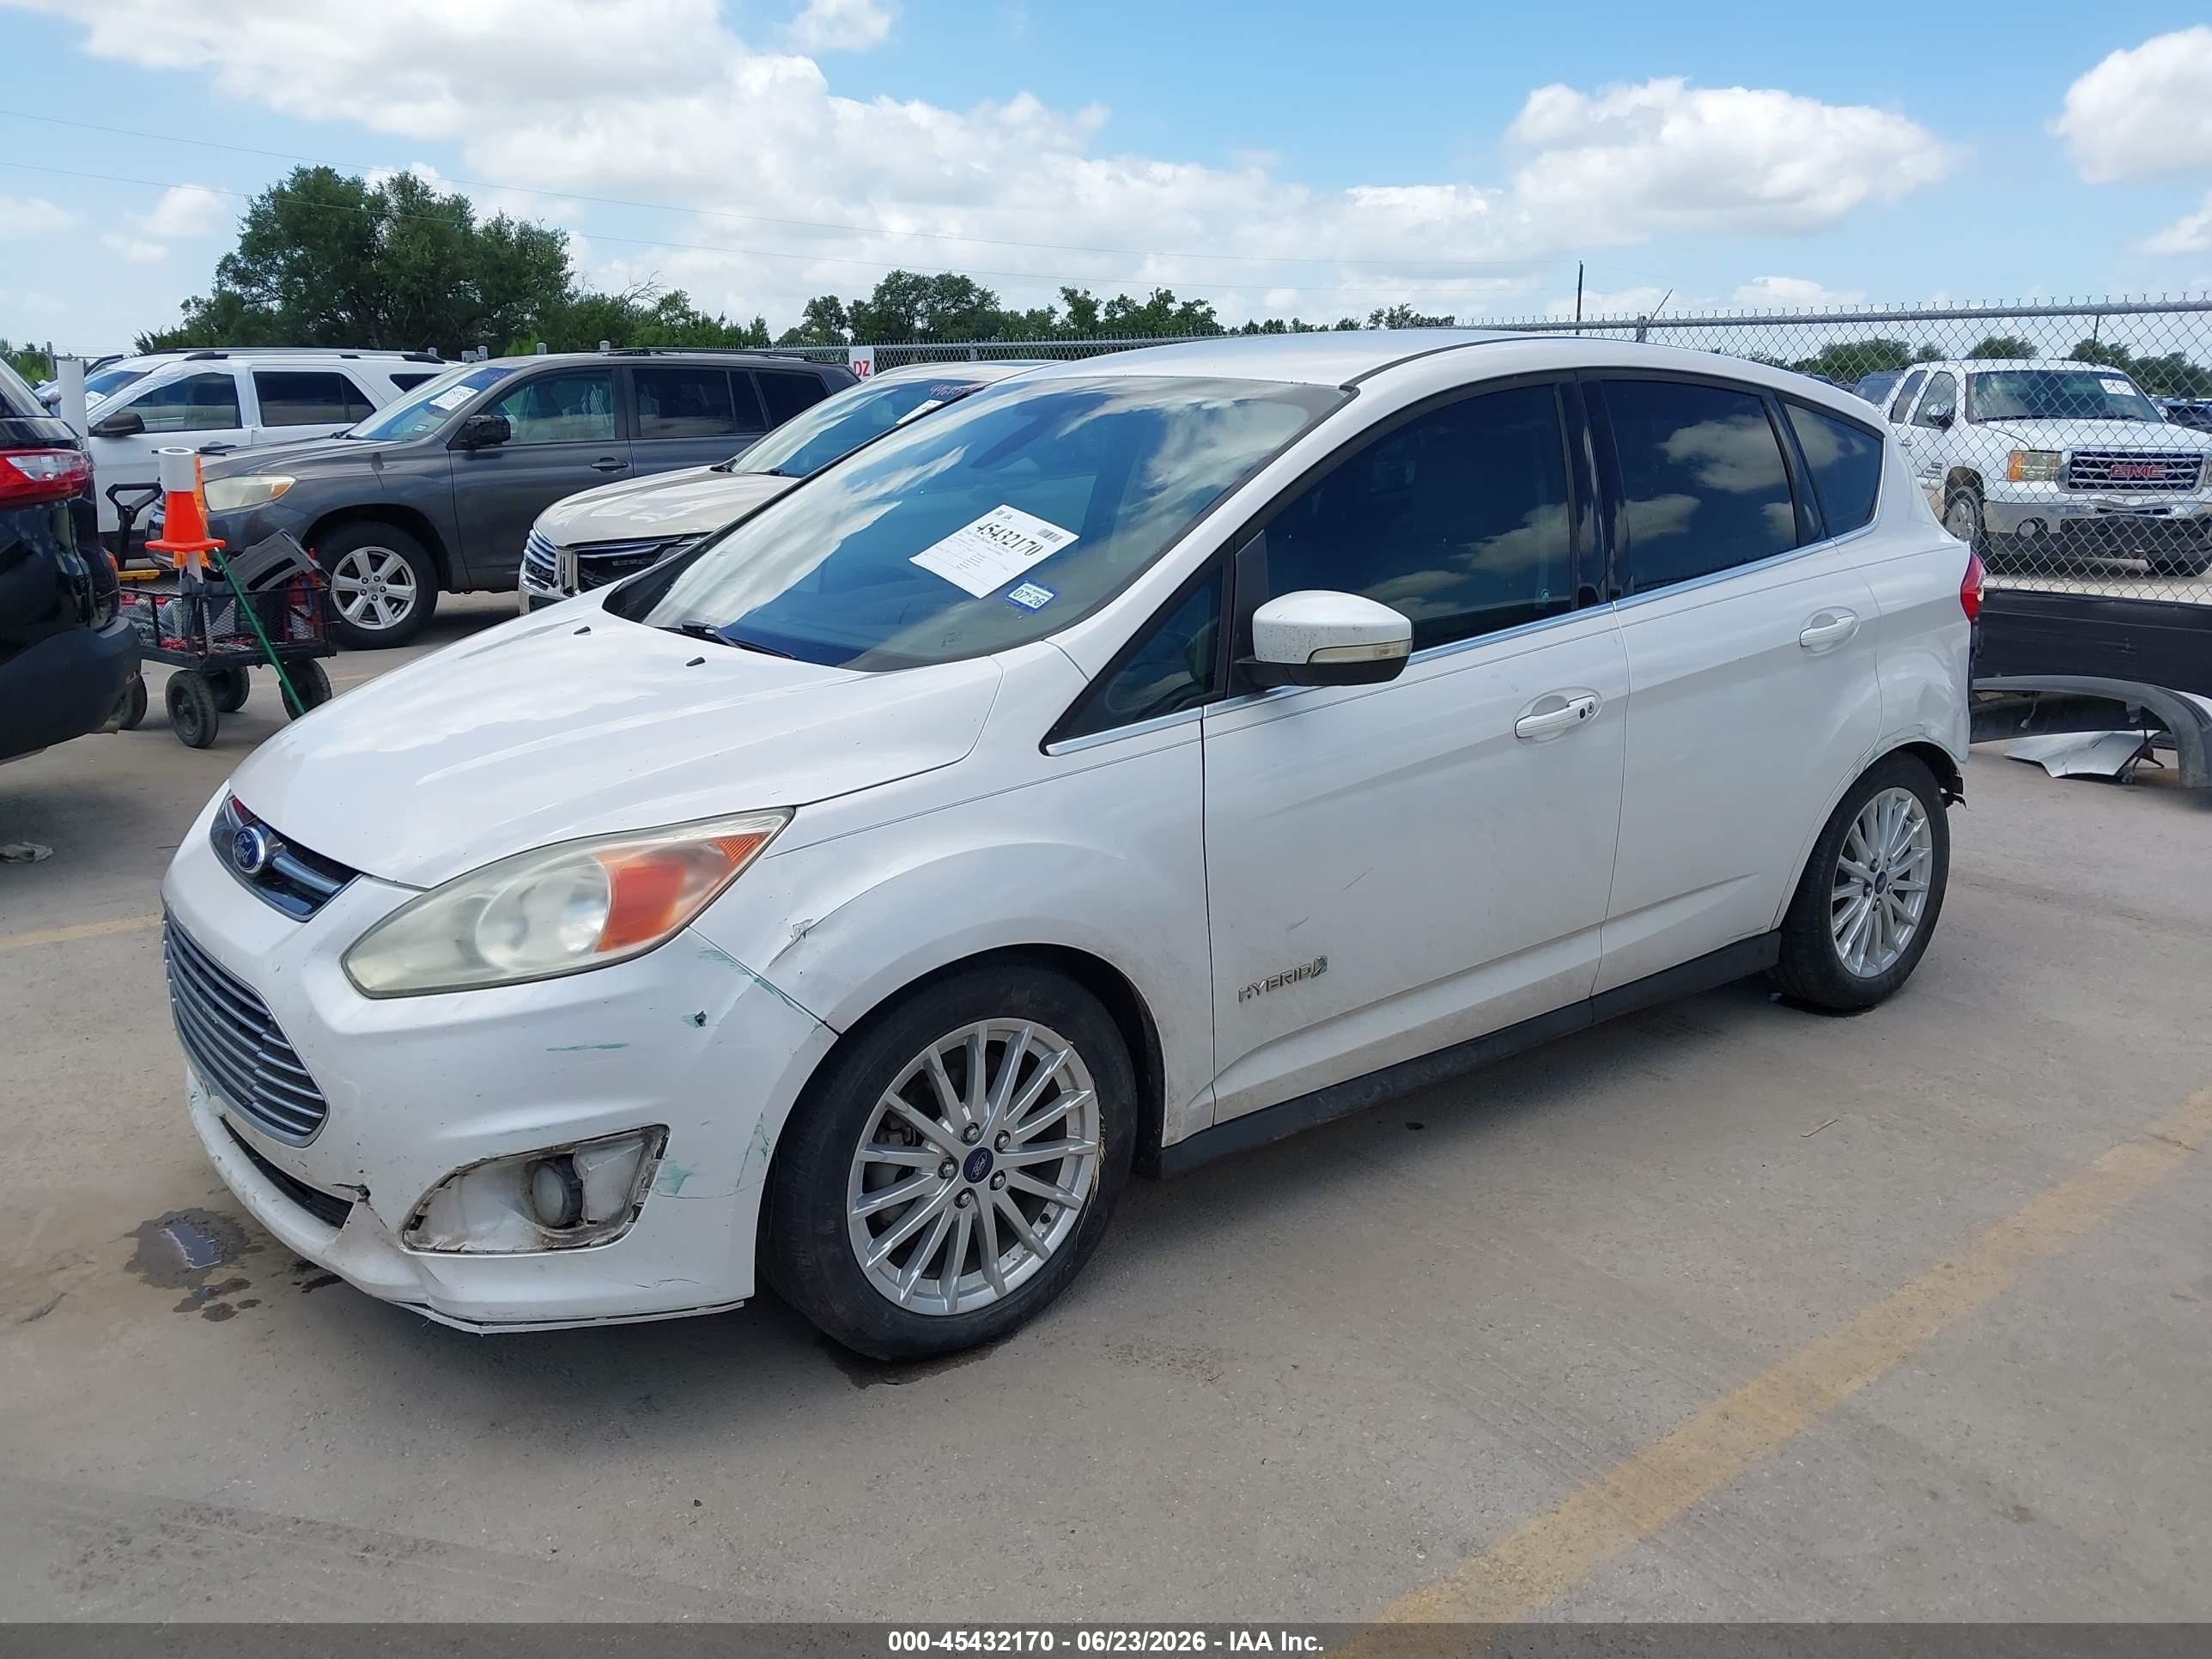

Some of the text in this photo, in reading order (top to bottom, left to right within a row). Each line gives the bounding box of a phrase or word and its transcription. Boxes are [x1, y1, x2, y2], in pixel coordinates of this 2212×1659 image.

[853, 360, 871, 377] DZ
[2110, 465, 2167, 478] GMC
[976, 522, 1044, 556] 45432170
[1012, 589, 1030, 599] 07
[1028, 596, 1045, 606] 26
[234, 833, 252, 864] Ford
[1238, 963, 1312, 1003] HYBRID
